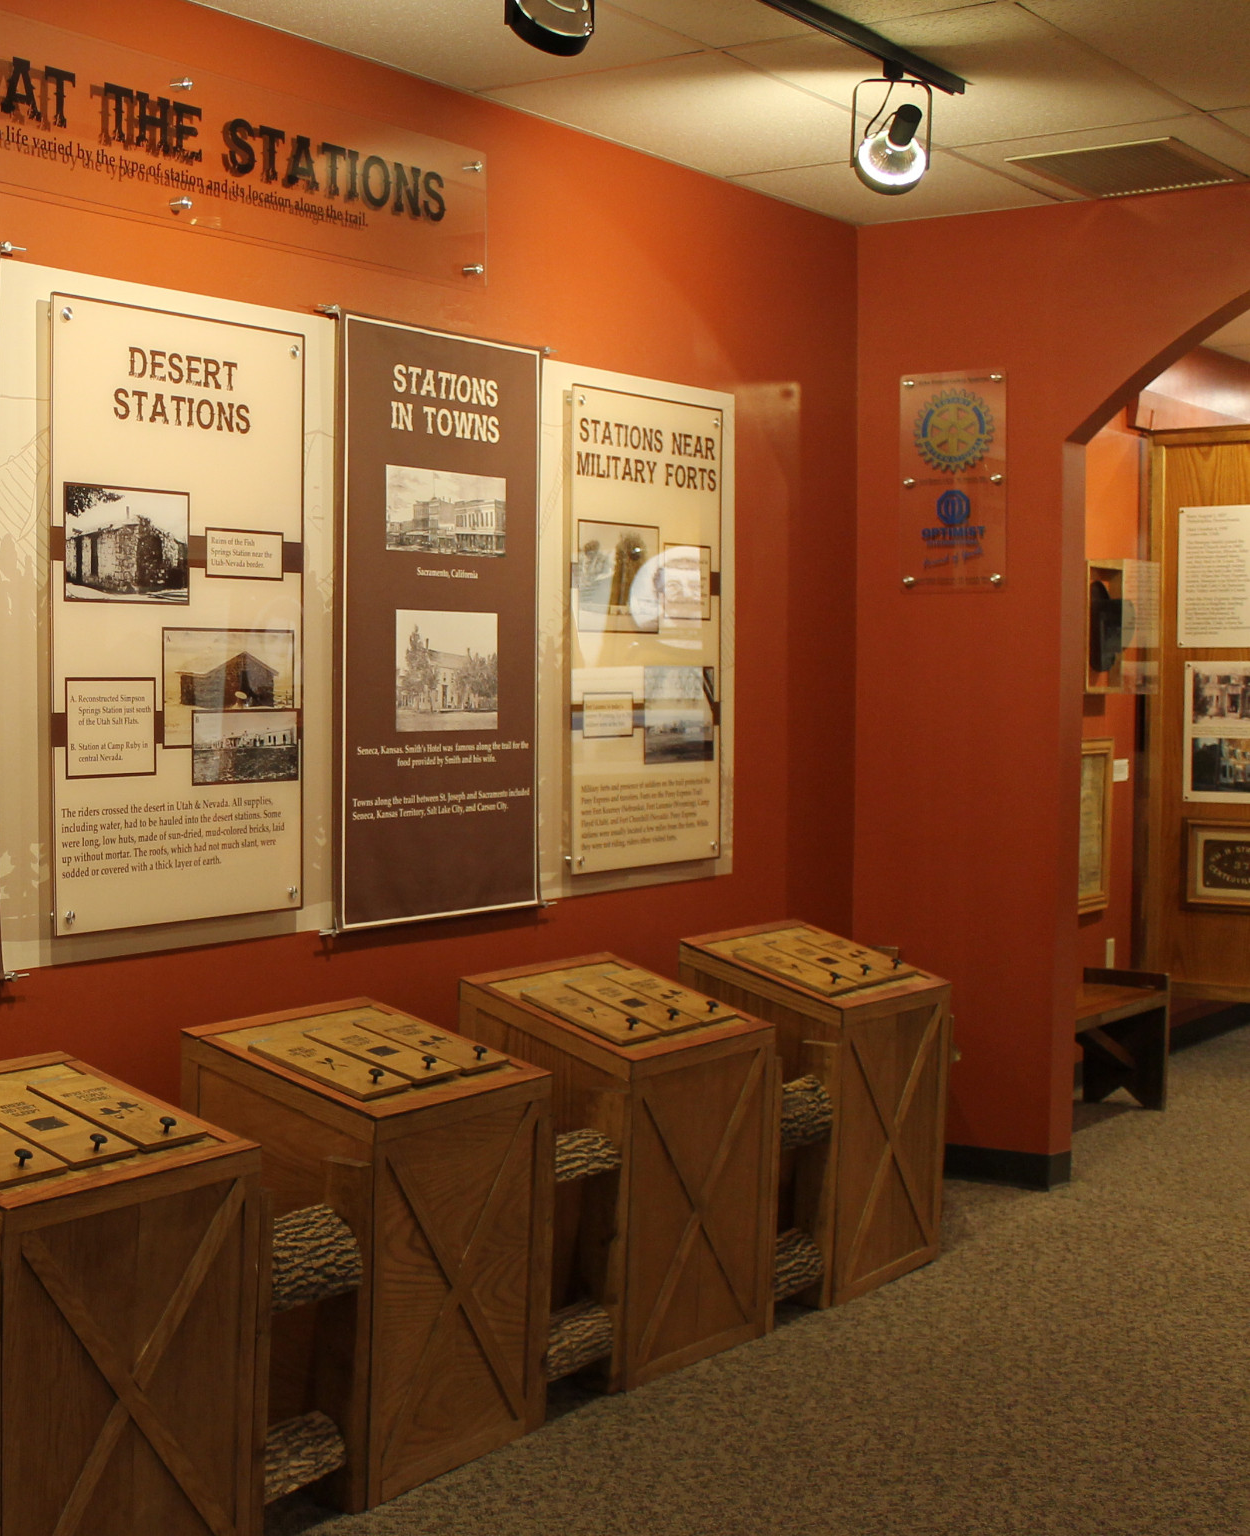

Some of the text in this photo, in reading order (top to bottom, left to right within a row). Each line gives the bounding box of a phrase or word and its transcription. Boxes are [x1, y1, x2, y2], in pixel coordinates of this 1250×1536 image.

[0, 56, 75, 129] AT
[104, 82, 202, 163] THE
[222, 118, 446, 223] STATIONS
[6, 126, 28, 145] life
[33, 137, 72, 156] varied
[77, 143, 92, 163] by
[96, 149, 116, 166] the
[119, 156, 146, 176] type
[149, 163, 162, 177] of
[164, 168, 203, 187] station
[207, 179, 228, 193] and
[232, 182, 245, 198] its
[248, 185, 291, 208] location
[295, 197, 323, 217] along
[325, 205, 343, 220] the
[344, 209, 369, 227] trail.
[128, 346, 238, 391] DESERT
[393, 363, 499, 408] STATIONS
[113, 387, 251, 434] STATIONS
[390, 401, 500, 444] IN TOWNS
[579, 417, 716, 461] STATIONS NEAR
[576, 451, 717, 492] MILITARY FORTS
[60, 808, 76, 818] The
[77, 807, 100, 817] riders
[101, 805, 128, 816] crossed
[130, 804, 142, 814] the
[143, 804, 165, 813] desert
[166, 802, 174, 812] in
[176, 801, 193, 811] Utah
[231, 798, 242, 808] All
